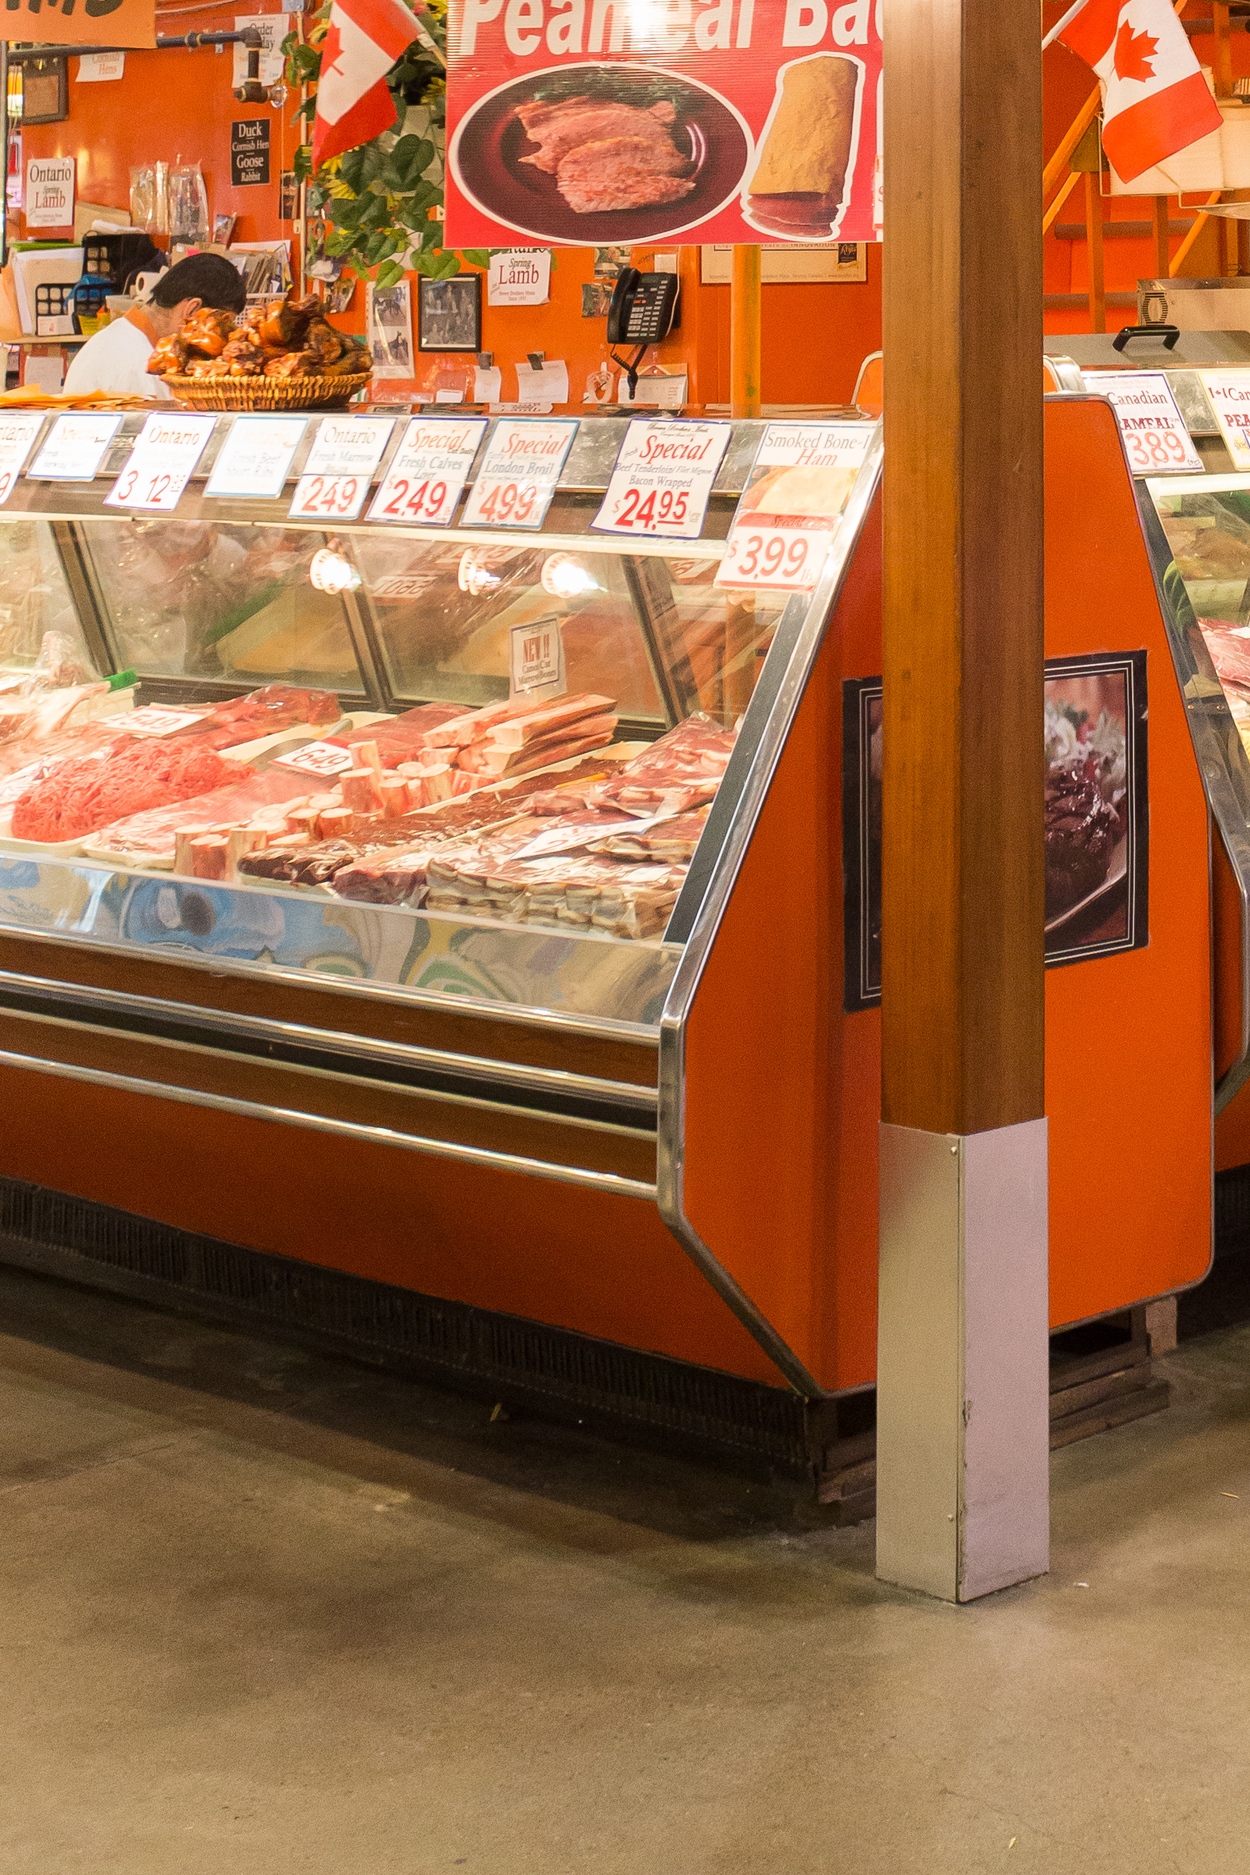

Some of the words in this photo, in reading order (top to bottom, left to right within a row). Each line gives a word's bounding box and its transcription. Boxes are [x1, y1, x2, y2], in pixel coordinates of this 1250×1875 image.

[239, 122, 262, 137] Duck
[236, 155, 264, 169] Goose
[30, 162, 71, 183] Ontario
[36, 192, 65, 209] Lamb
[499, 264, 540, 285] Lamb
[1106, 390, 1169, 406] Canadian
[149, 426, 200, 445] Ontario
[324, 426, 377, 444] Ontario
[409, 428, 471, 452] Special
[765, 432, 823, 449] Smoked
[501, 433, 569, 459] Special
[639, 435, 714, 465] Special
[398, 455, 425, 469] Fresh
[430, 456, 464, 470] Calves
[794, 448, 838, 466] Ham
[484, 461, 524, 474] London
[526, 462, 554, 475] Broil
[616, 463, 632, 472] Beef
[118, 470, 139, 501] 3
[629, 475, 654, 486] Bacon
[657, 476, 694, 490] Wrapped
[727, 535, 809, 581] $3.99
